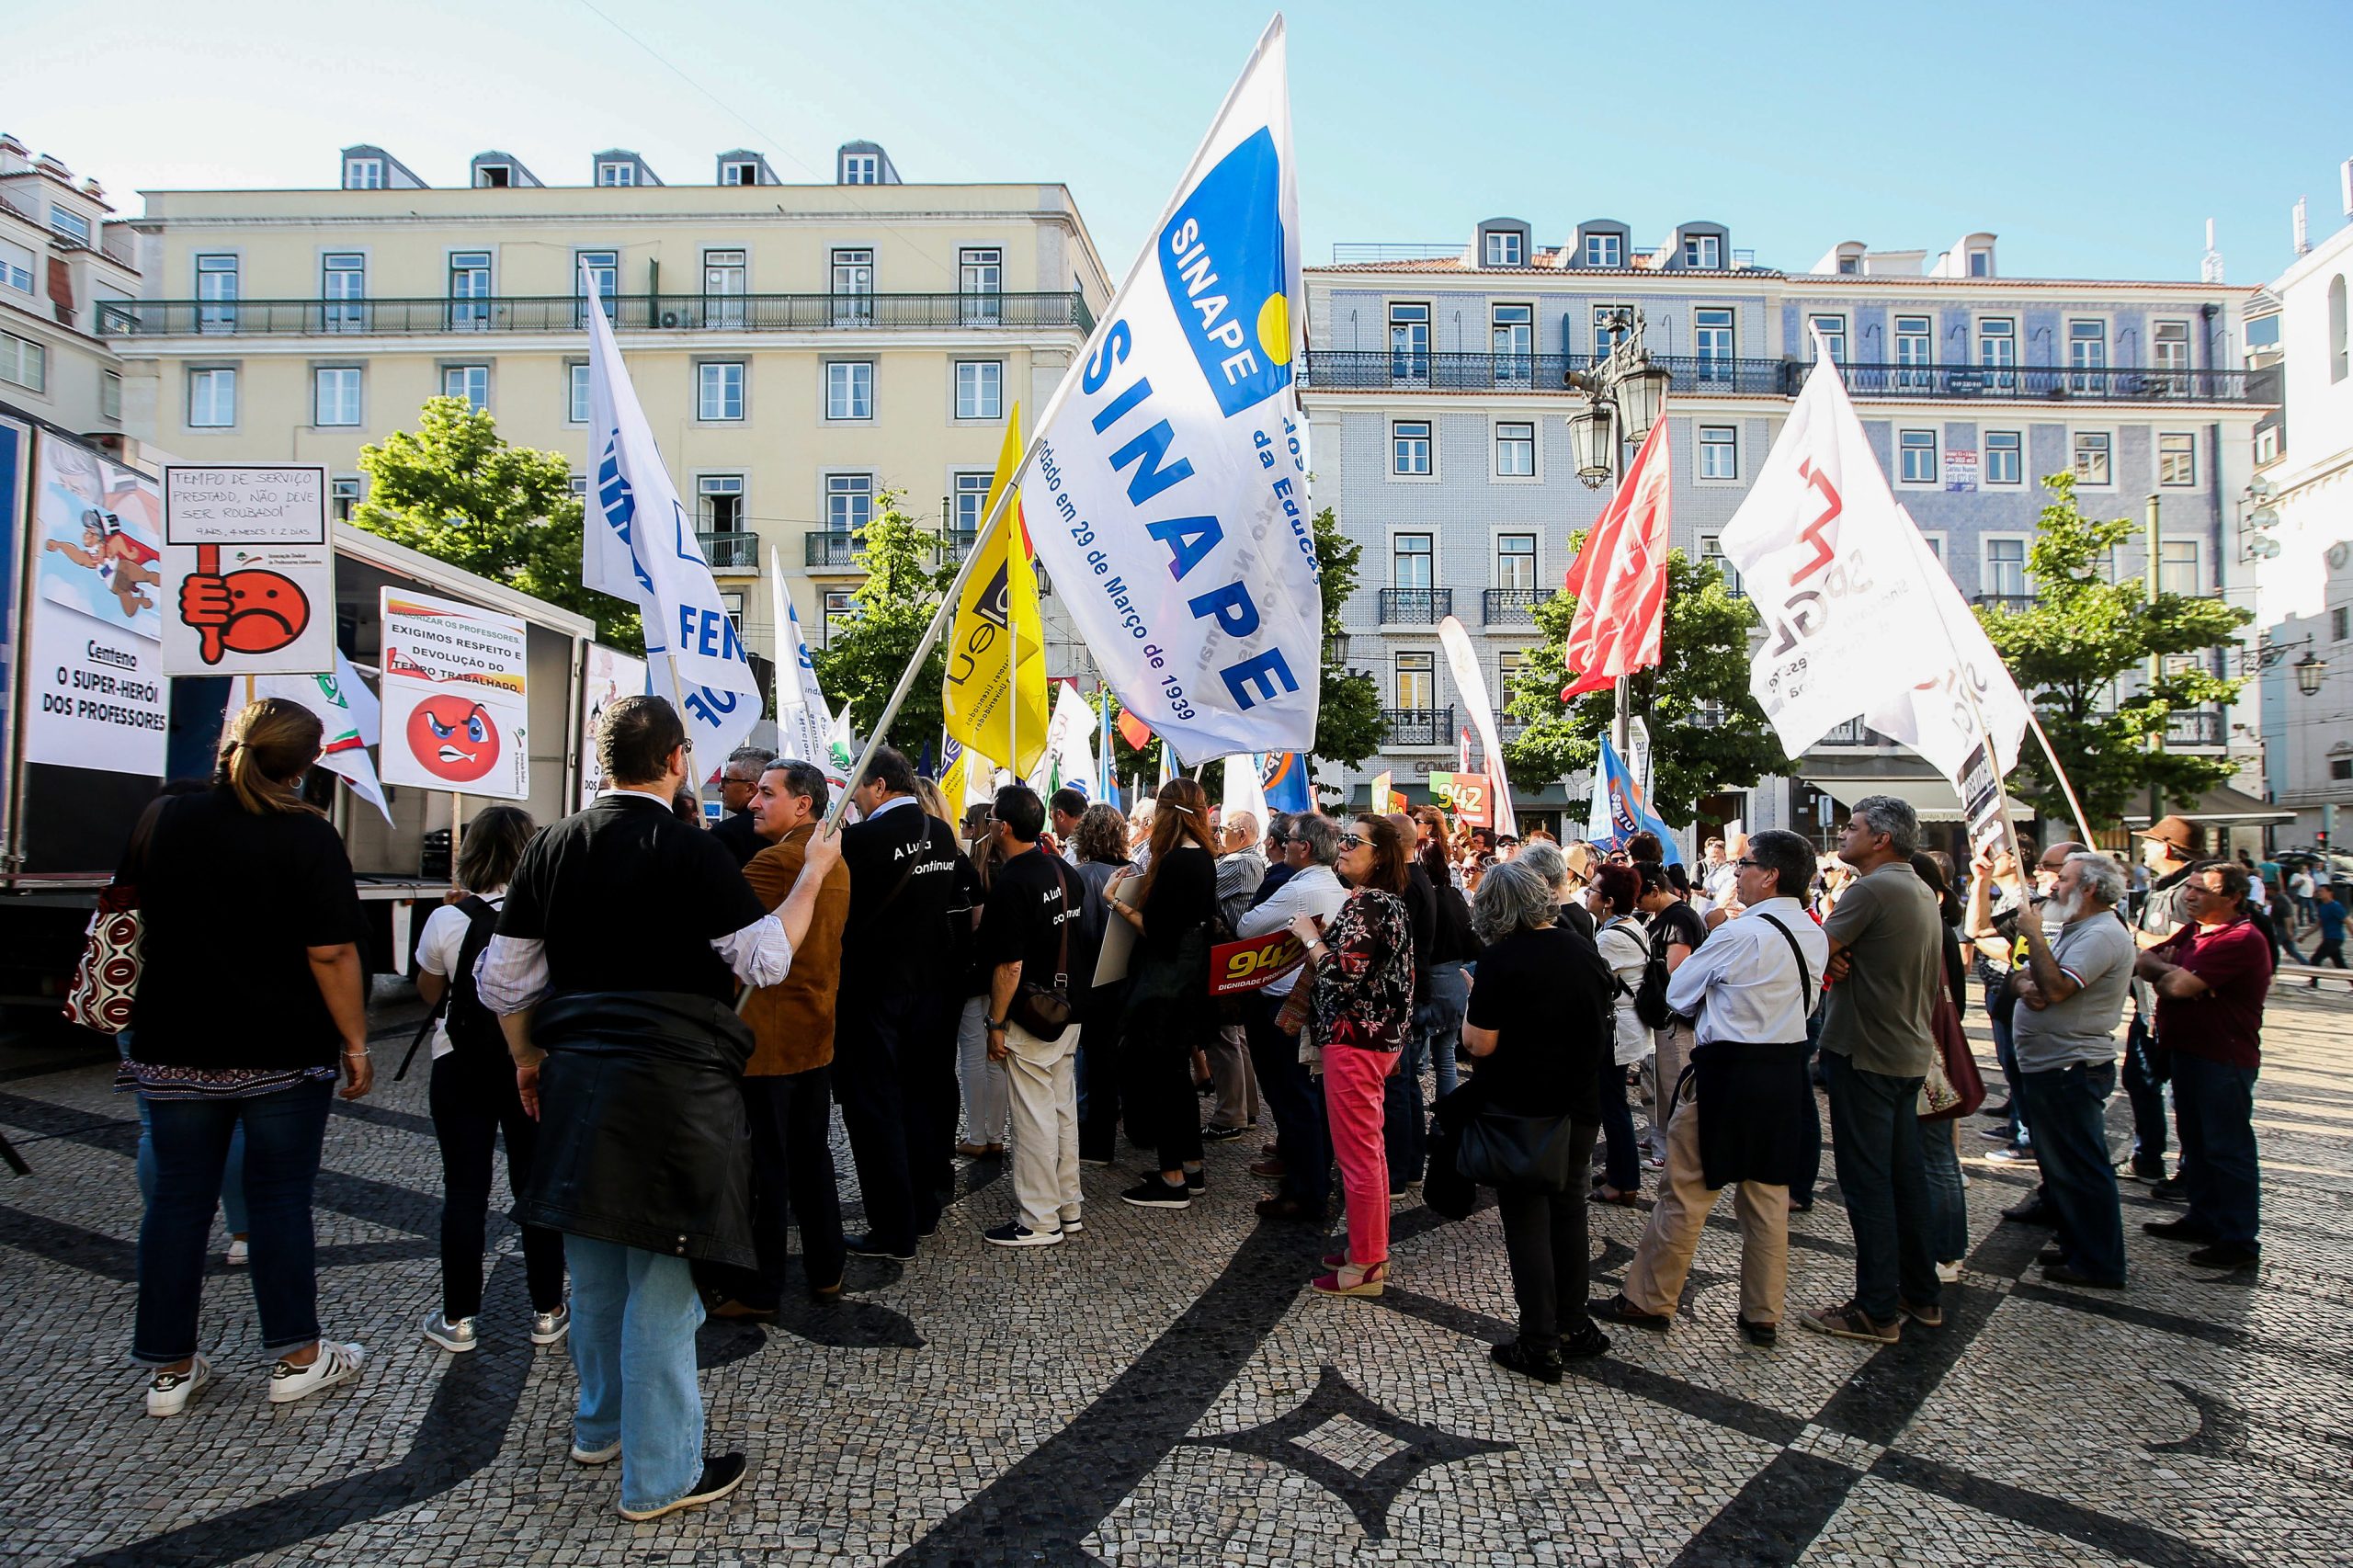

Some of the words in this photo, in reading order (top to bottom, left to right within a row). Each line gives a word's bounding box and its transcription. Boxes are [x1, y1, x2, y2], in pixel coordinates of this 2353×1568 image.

[1171, 218, 1259, 386] SINAPE
[1253, 429, 1276, 470] da
[232, 473, 249, 485] DE
[255, 472, 313, 487] SERVIÇO
[250, 488, 278, 504] NÃO
[286, 491, 315, 503] DEVE
[180, 508, 216, 520] SER
[1082, 318, 1299, 711] SINAPE
[1039, 438, 1061, 492] ndado
[1056, 492, 1077, 523] em
[1071, 520, 1096, 548] 29
[1086, 550, 1108, 576] de
[1103, 574, 1148, 640] Março
[1142, 643, 1165, 671] de
[1161, 674, 1196, 722] 1939
[444, 620, 458, 630] OS
[88, 640, 137, 667] Centeno
[392, 624, 452, 644] EXIGIMOS
[456, 638, 512, 657] RESPEITO
[515, 652, 521, 660] E
[392, 660, 436, 676] TEMPO
[413, 646, 484, 668] DEVOLUÇÃO
[488, 662, 504, 673] DO
[58, 666, 67, 686] O
[73, 670, 158, 703] SUPER-HERÓI
[43, 692, 73, 716] DOS
[78, 699, 165, 731] PROFESSORES
[585, 779, 597, 790] DOS
[1438, 783, 1483, 812] 942
[1610, 792, 1635, 833] SPLIU
[893, 847, 904, 860] A
[907, 839, 932, 855] Lua
[911, 859, 955, 875] ontinua!
[1043, 892, 1050, 904] A
[1051, 886, 1062, 900] Lut
[1052, 906, 1081, 926] conua!
[1226, 937, 1302, 979] 942
[1218, 978, 1261, 991] DIGNIDADE
